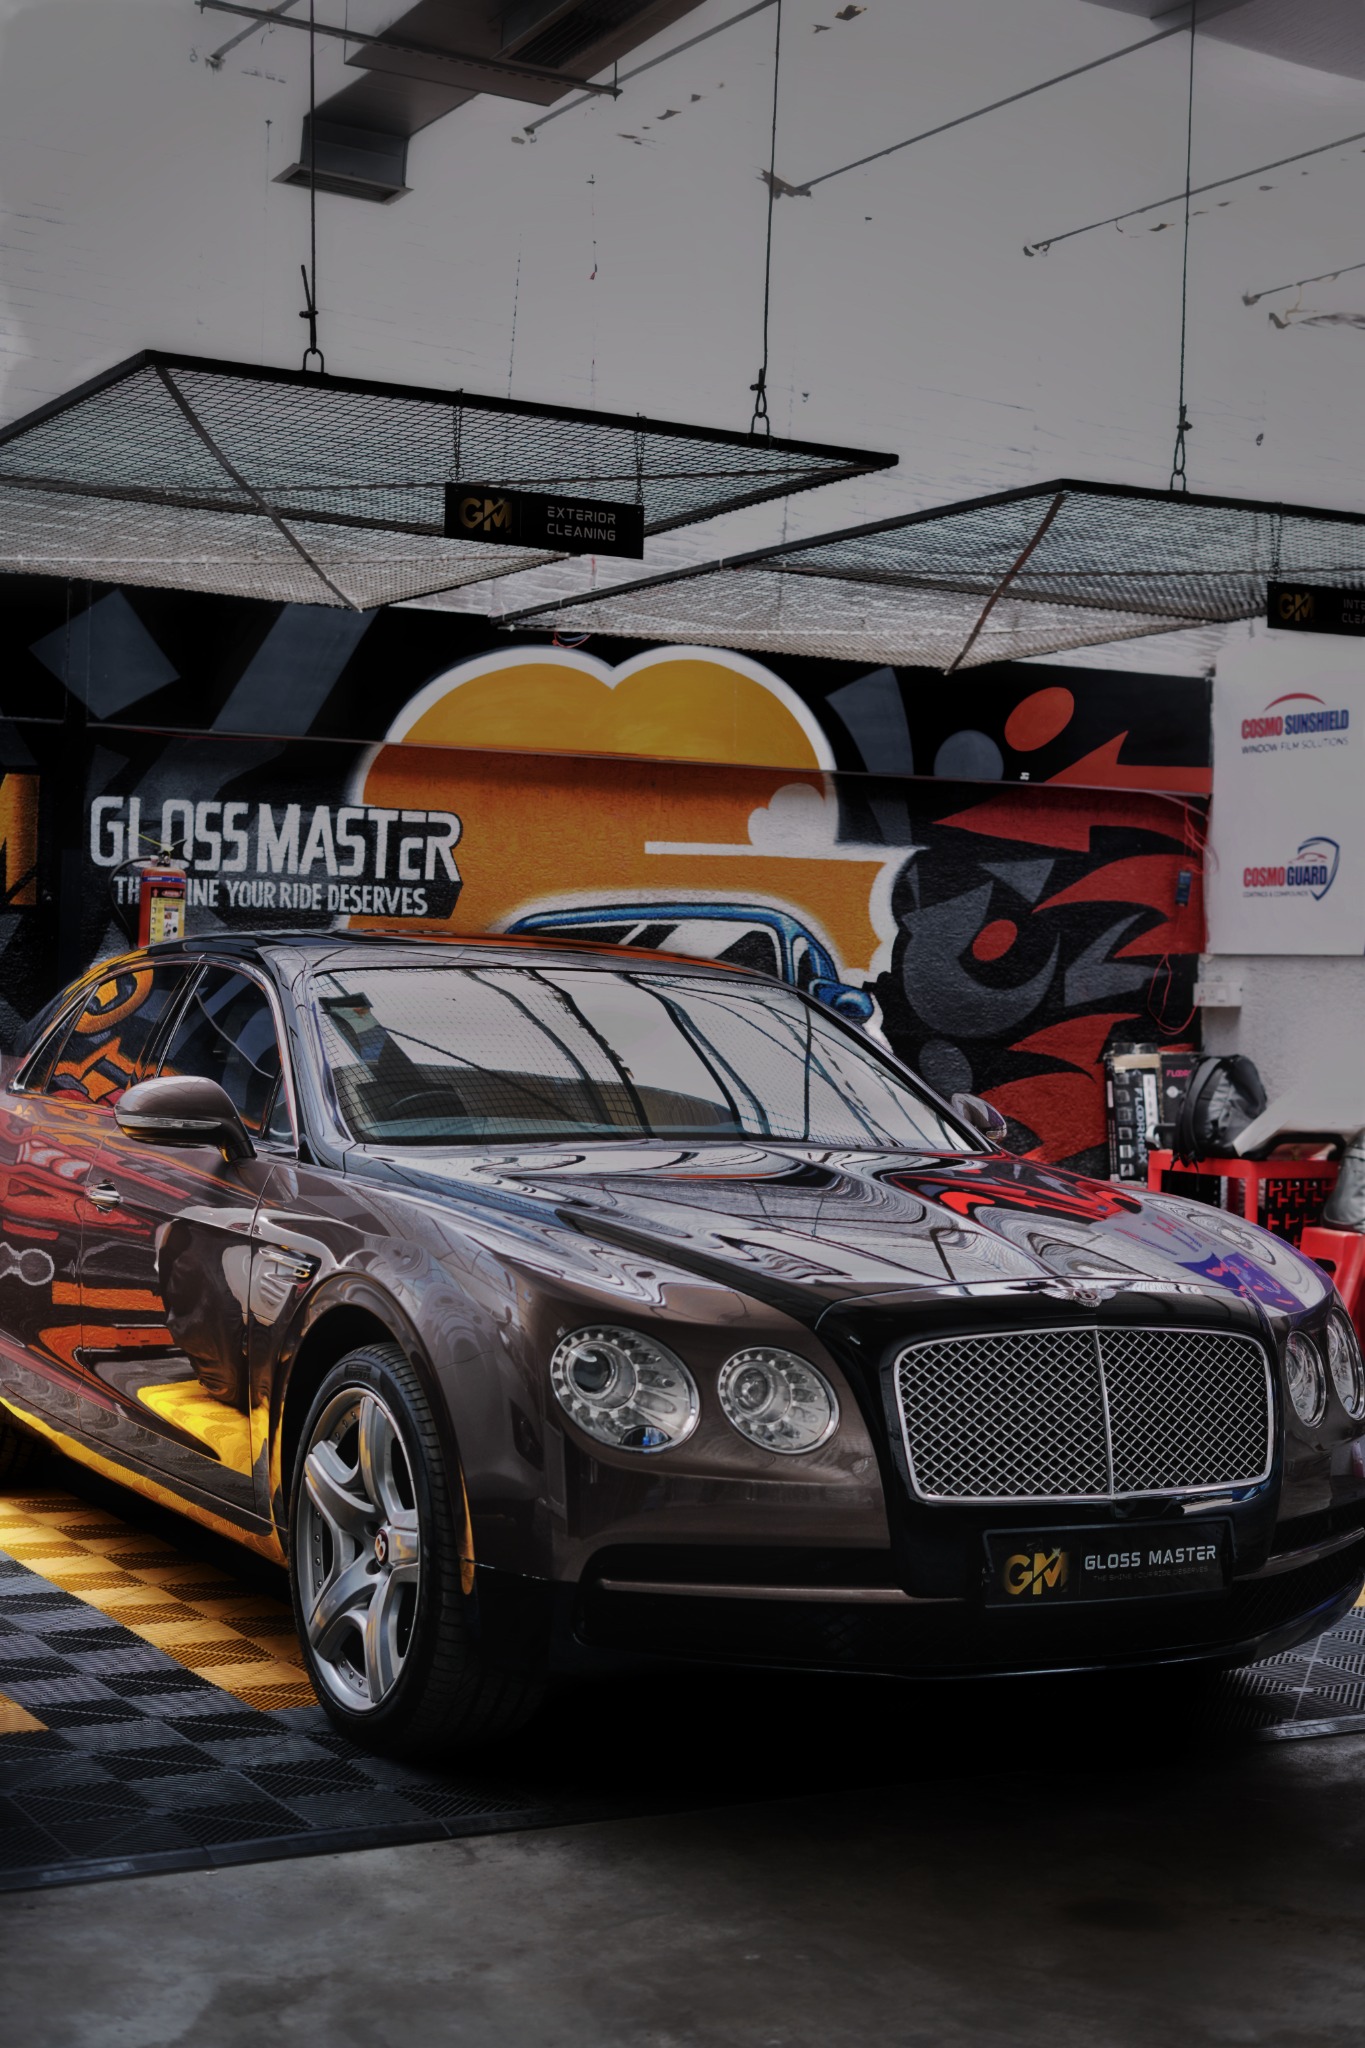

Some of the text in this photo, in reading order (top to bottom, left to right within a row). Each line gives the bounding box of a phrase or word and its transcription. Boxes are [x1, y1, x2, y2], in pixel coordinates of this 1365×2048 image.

[546, 505, 617, 526] EXTERIOR
[546, 523, 617, 542] CLEANING
[1241, 709, 1350, 740] COSMO SUNSHIELD
[1241, 743, 1278, 754] WINDOW
[90, 795, 250, 873] GLOSS
[256, 803, 462, 883] MASTER
[1243, 865, 1329, 888] COSMO GUARD
[225, 880, 277, 910] YOUR
[279, 882, 323, 912] RIDE
[327, 884, 429, 917] DESERVES
[1084, 1544, 1217, 1571] GLOSS MASTER
